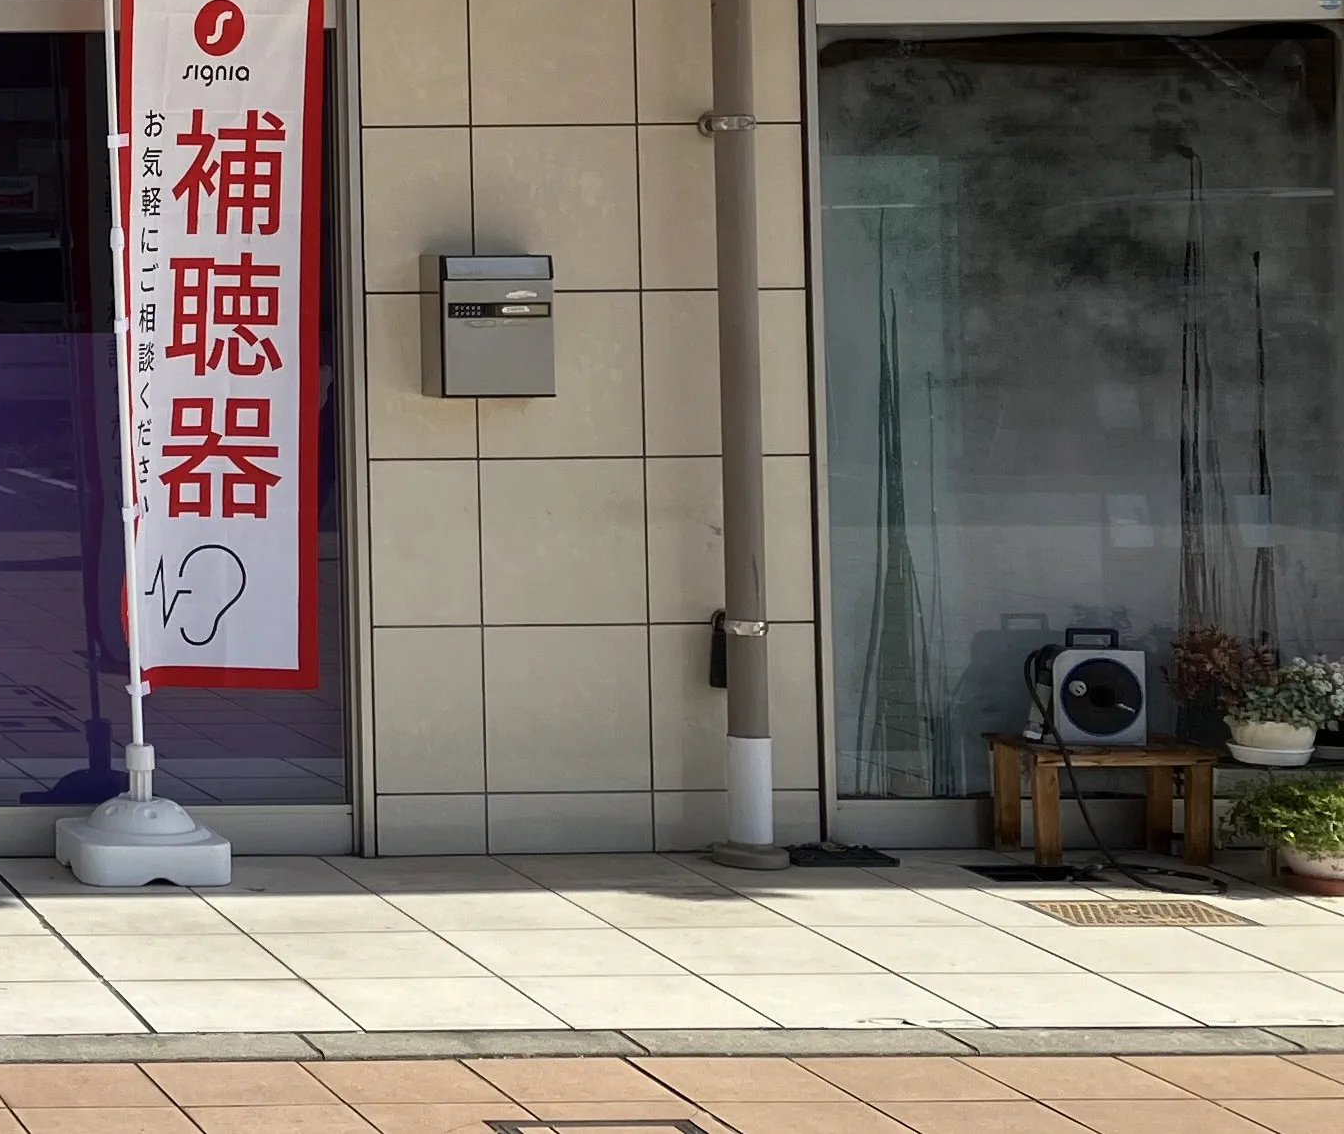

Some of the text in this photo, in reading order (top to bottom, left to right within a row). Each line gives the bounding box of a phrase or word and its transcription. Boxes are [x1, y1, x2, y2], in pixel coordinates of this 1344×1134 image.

[182, 65, 249, 87] signia
[159, 109, 286, 519] 補聴器
